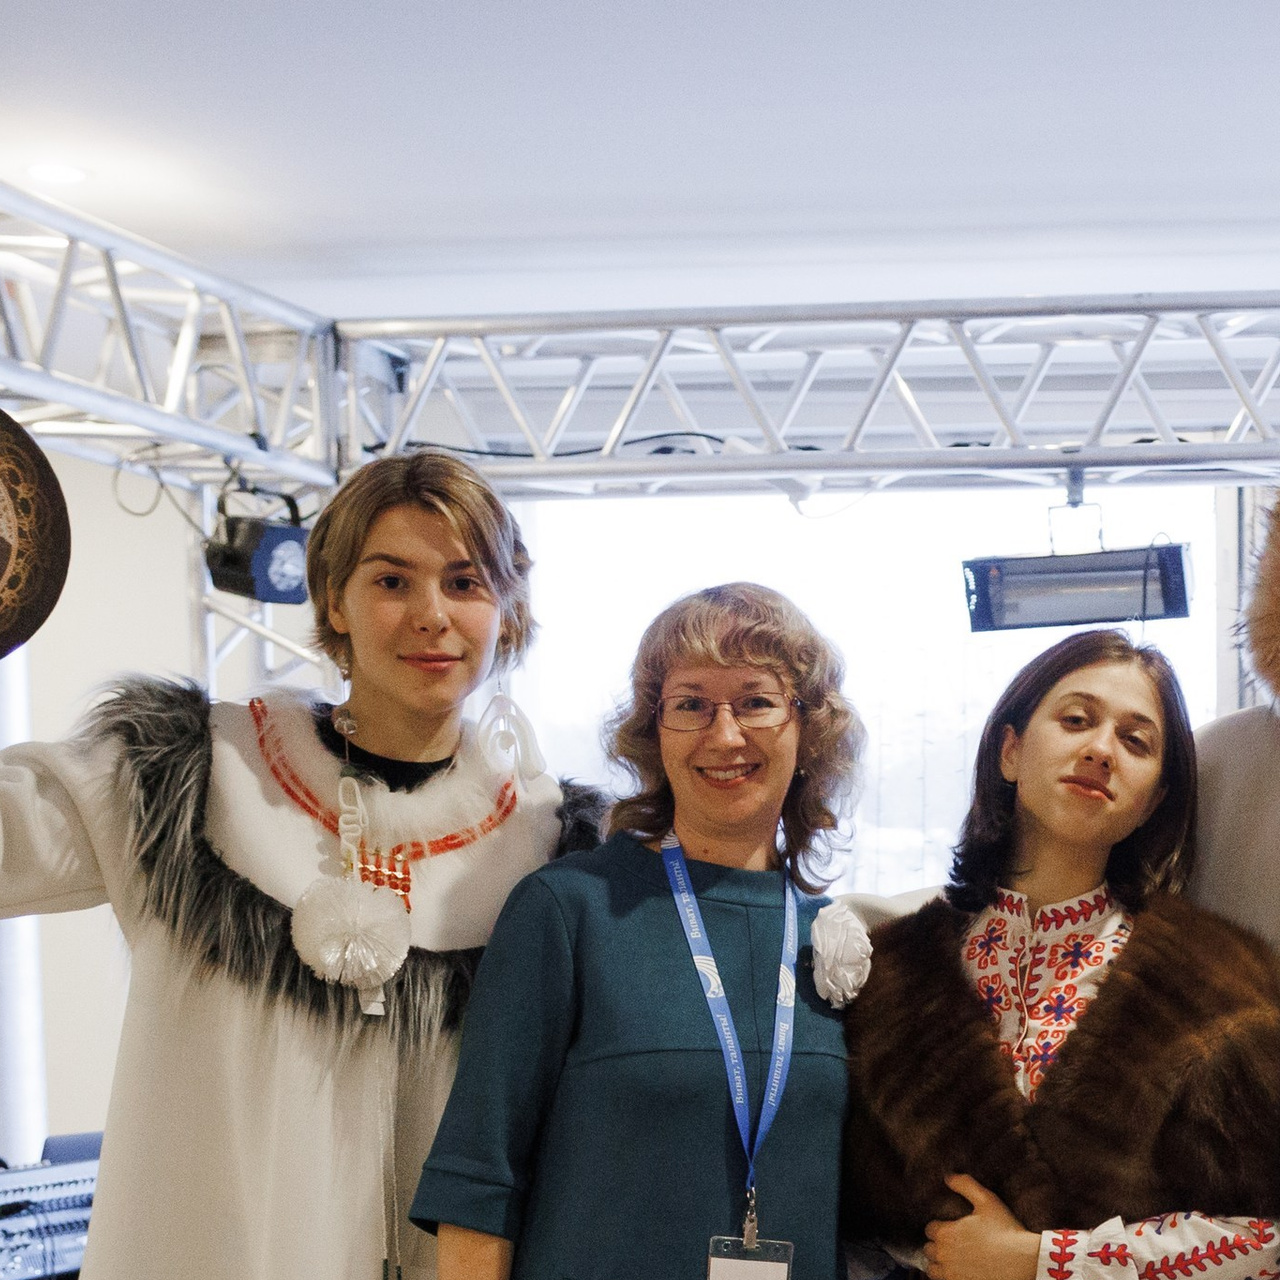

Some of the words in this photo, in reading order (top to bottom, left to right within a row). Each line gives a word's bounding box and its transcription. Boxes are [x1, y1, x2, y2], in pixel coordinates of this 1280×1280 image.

[669, 859, 690, 904] таланты!
[686, 904, 702, 939] Виват,
[716, 1014, 738, 1064] таланты!
[776, 1022, 789, 1053] Виват,
[733, 1066, 744, 1104] Виват,
[768, 1055, 784, 1107] таланты!
